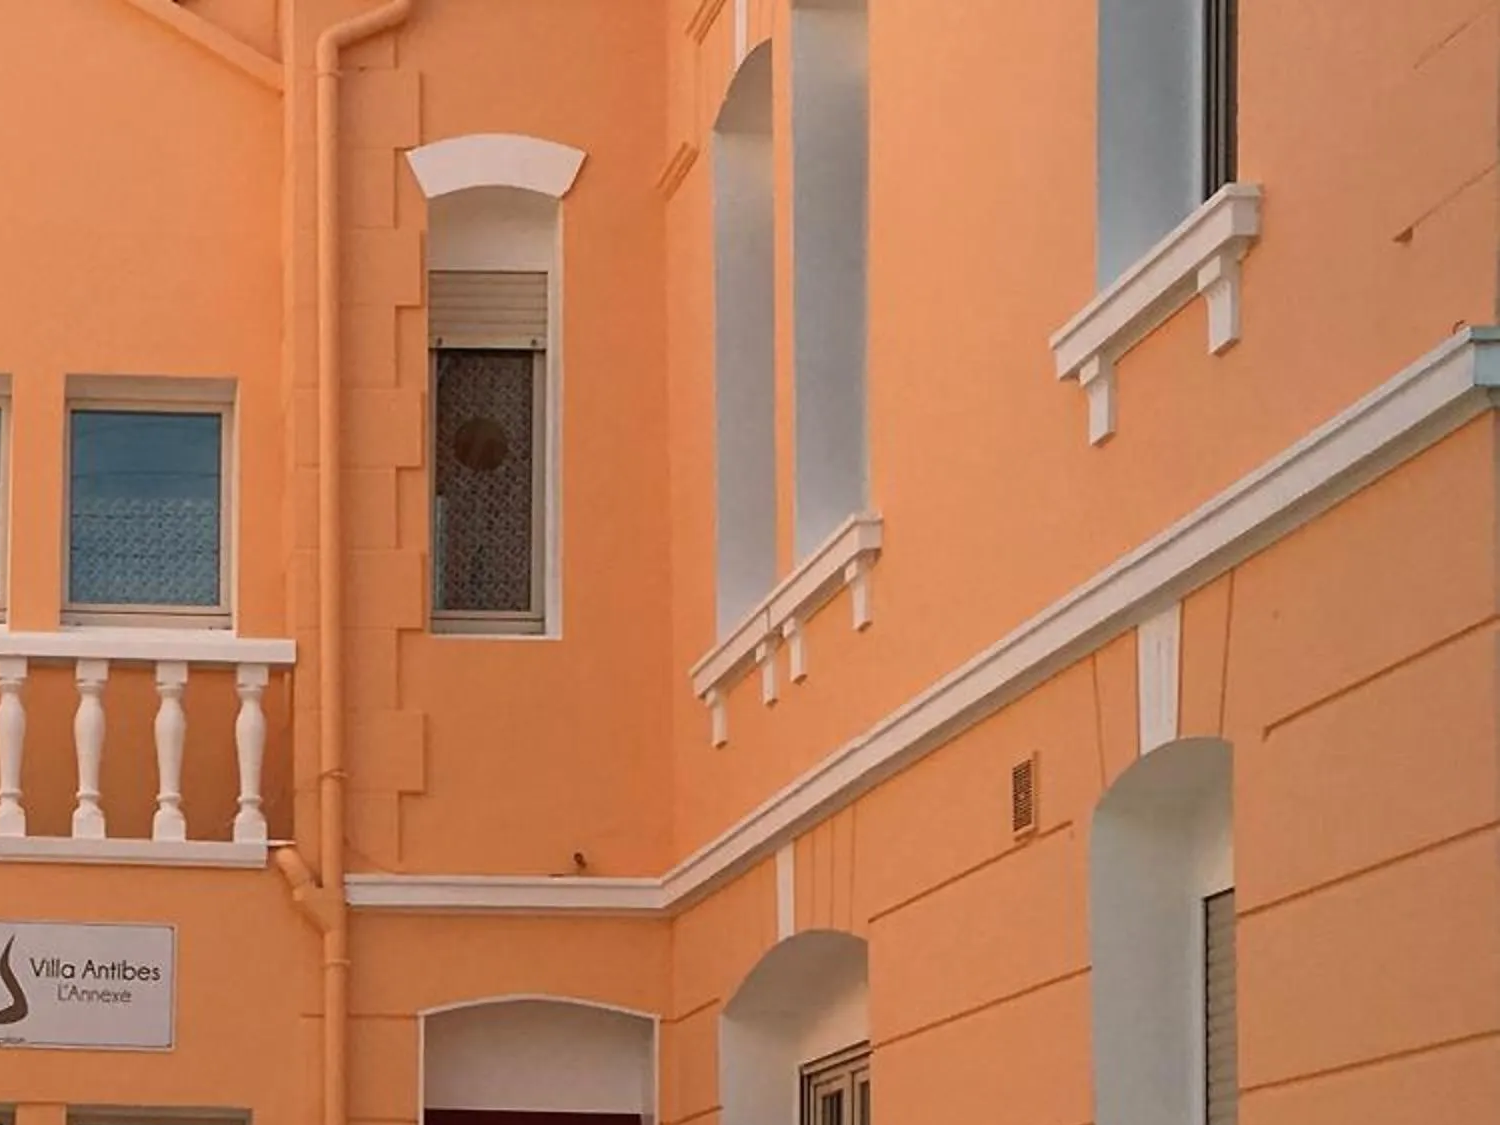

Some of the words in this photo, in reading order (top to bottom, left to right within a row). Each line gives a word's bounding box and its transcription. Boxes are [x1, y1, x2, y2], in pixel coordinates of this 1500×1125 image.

[30, 957, 75, 979] Villa
[82, 959, 161, 981] Antibes
[57, 982, 132, 1004] L'Annexe
